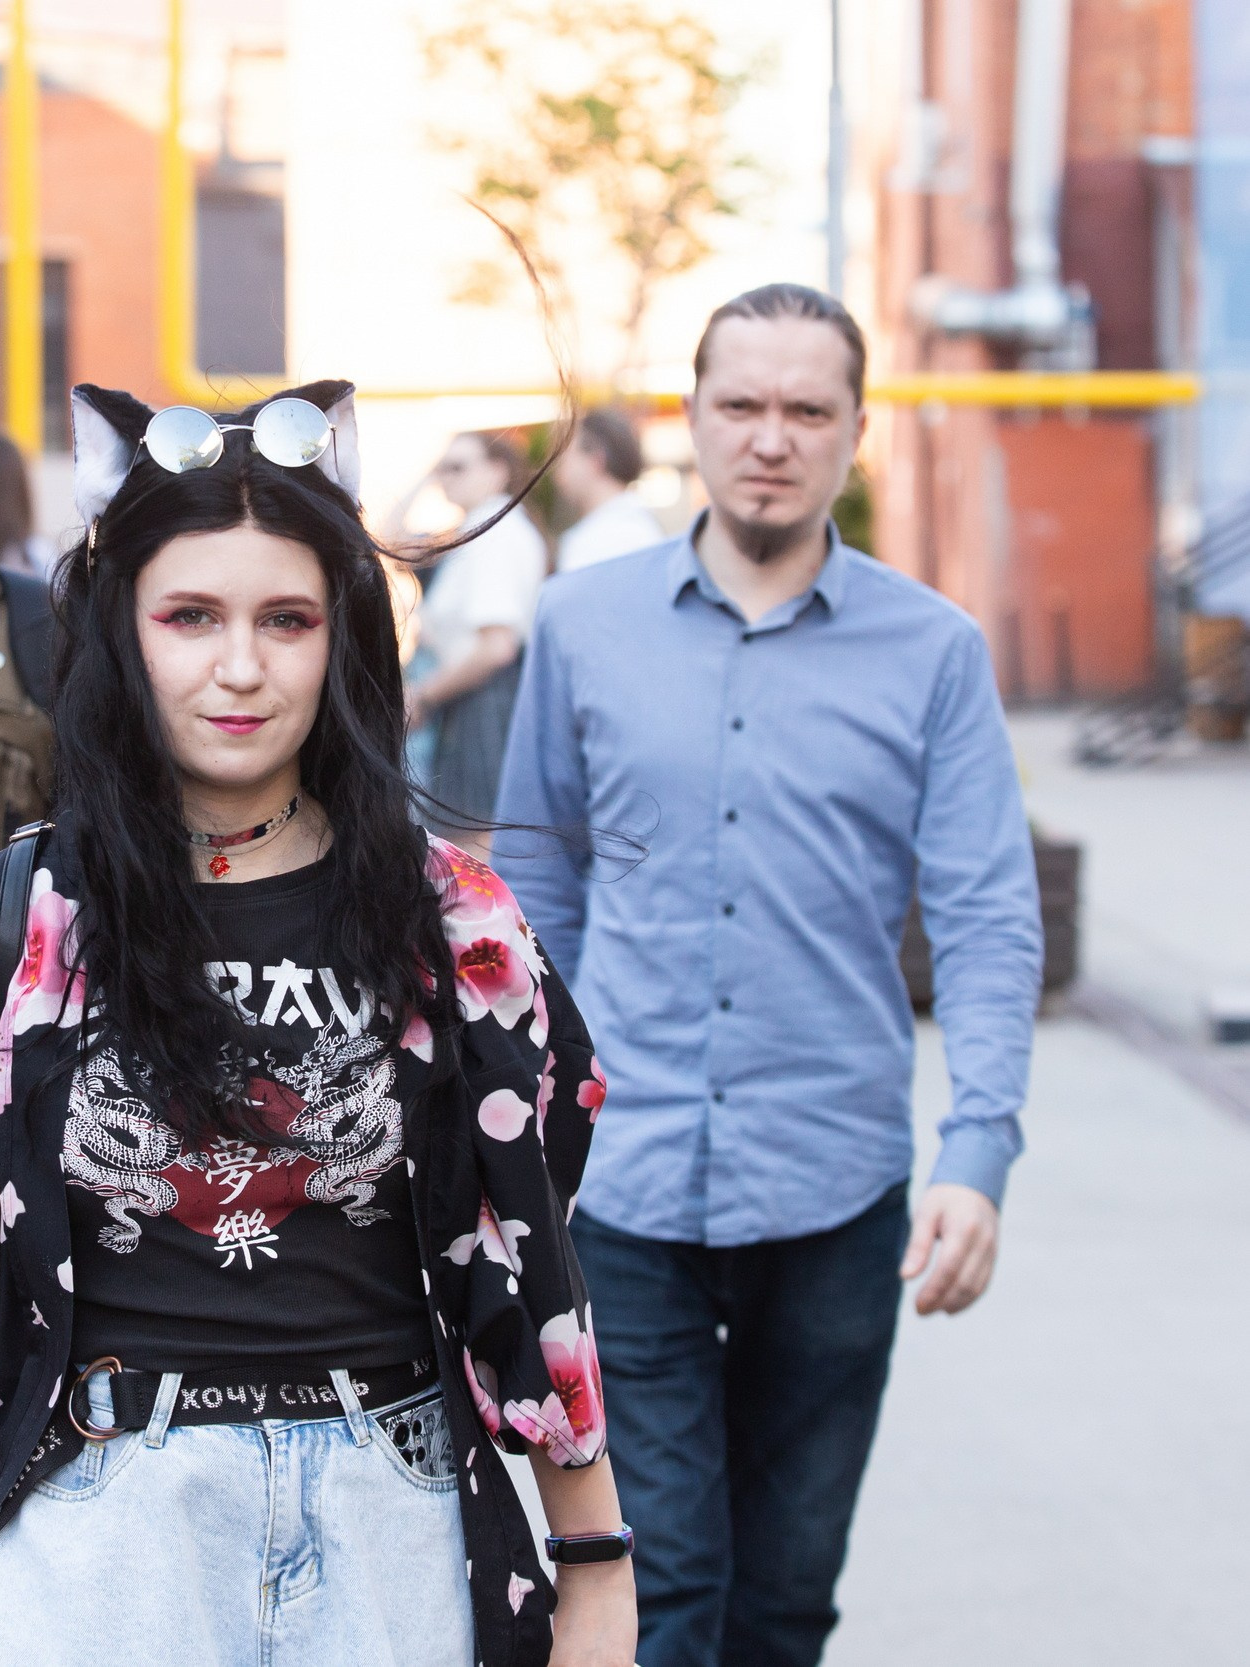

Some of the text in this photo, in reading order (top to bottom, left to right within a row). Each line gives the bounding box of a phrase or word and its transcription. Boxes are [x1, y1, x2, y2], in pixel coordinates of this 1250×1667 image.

[202, 958, 394, 1039] RAV
[181, 1383, 268, 1415] хочу
[279, 1378, 370, 1406] спаь
